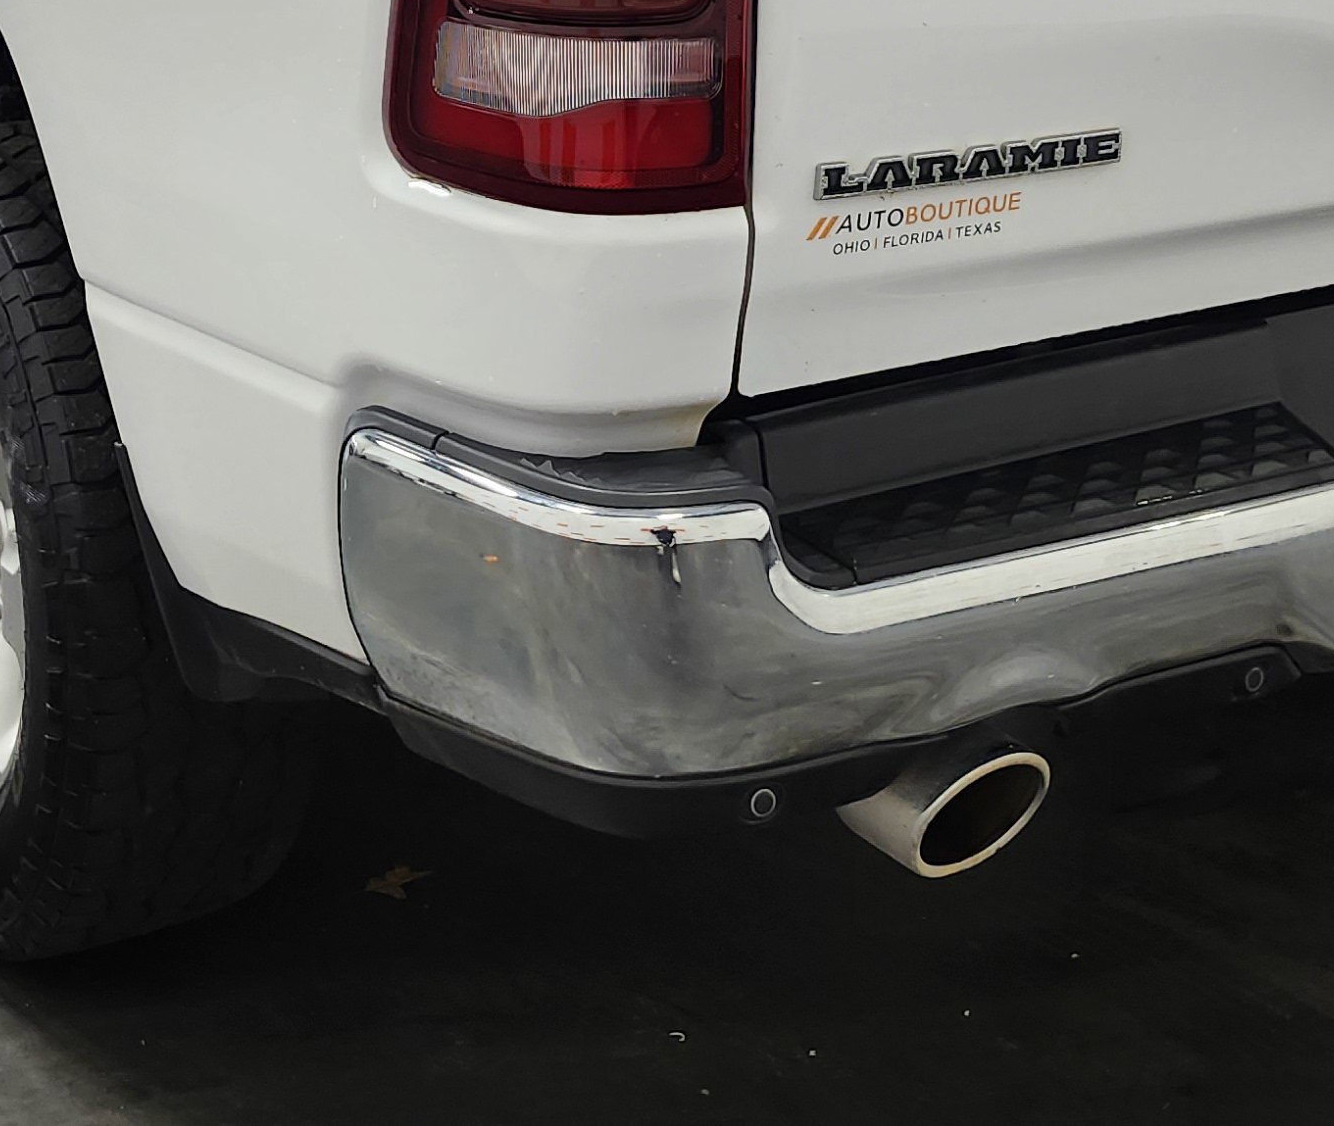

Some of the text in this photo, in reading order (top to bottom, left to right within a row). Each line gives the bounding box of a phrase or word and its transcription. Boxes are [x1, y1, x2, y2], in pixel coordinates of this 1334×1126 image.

[813, 128, 1122, 201] LARAMIE
[832, 221, 1002, 256] OHIO FLORIDA TEXAS
